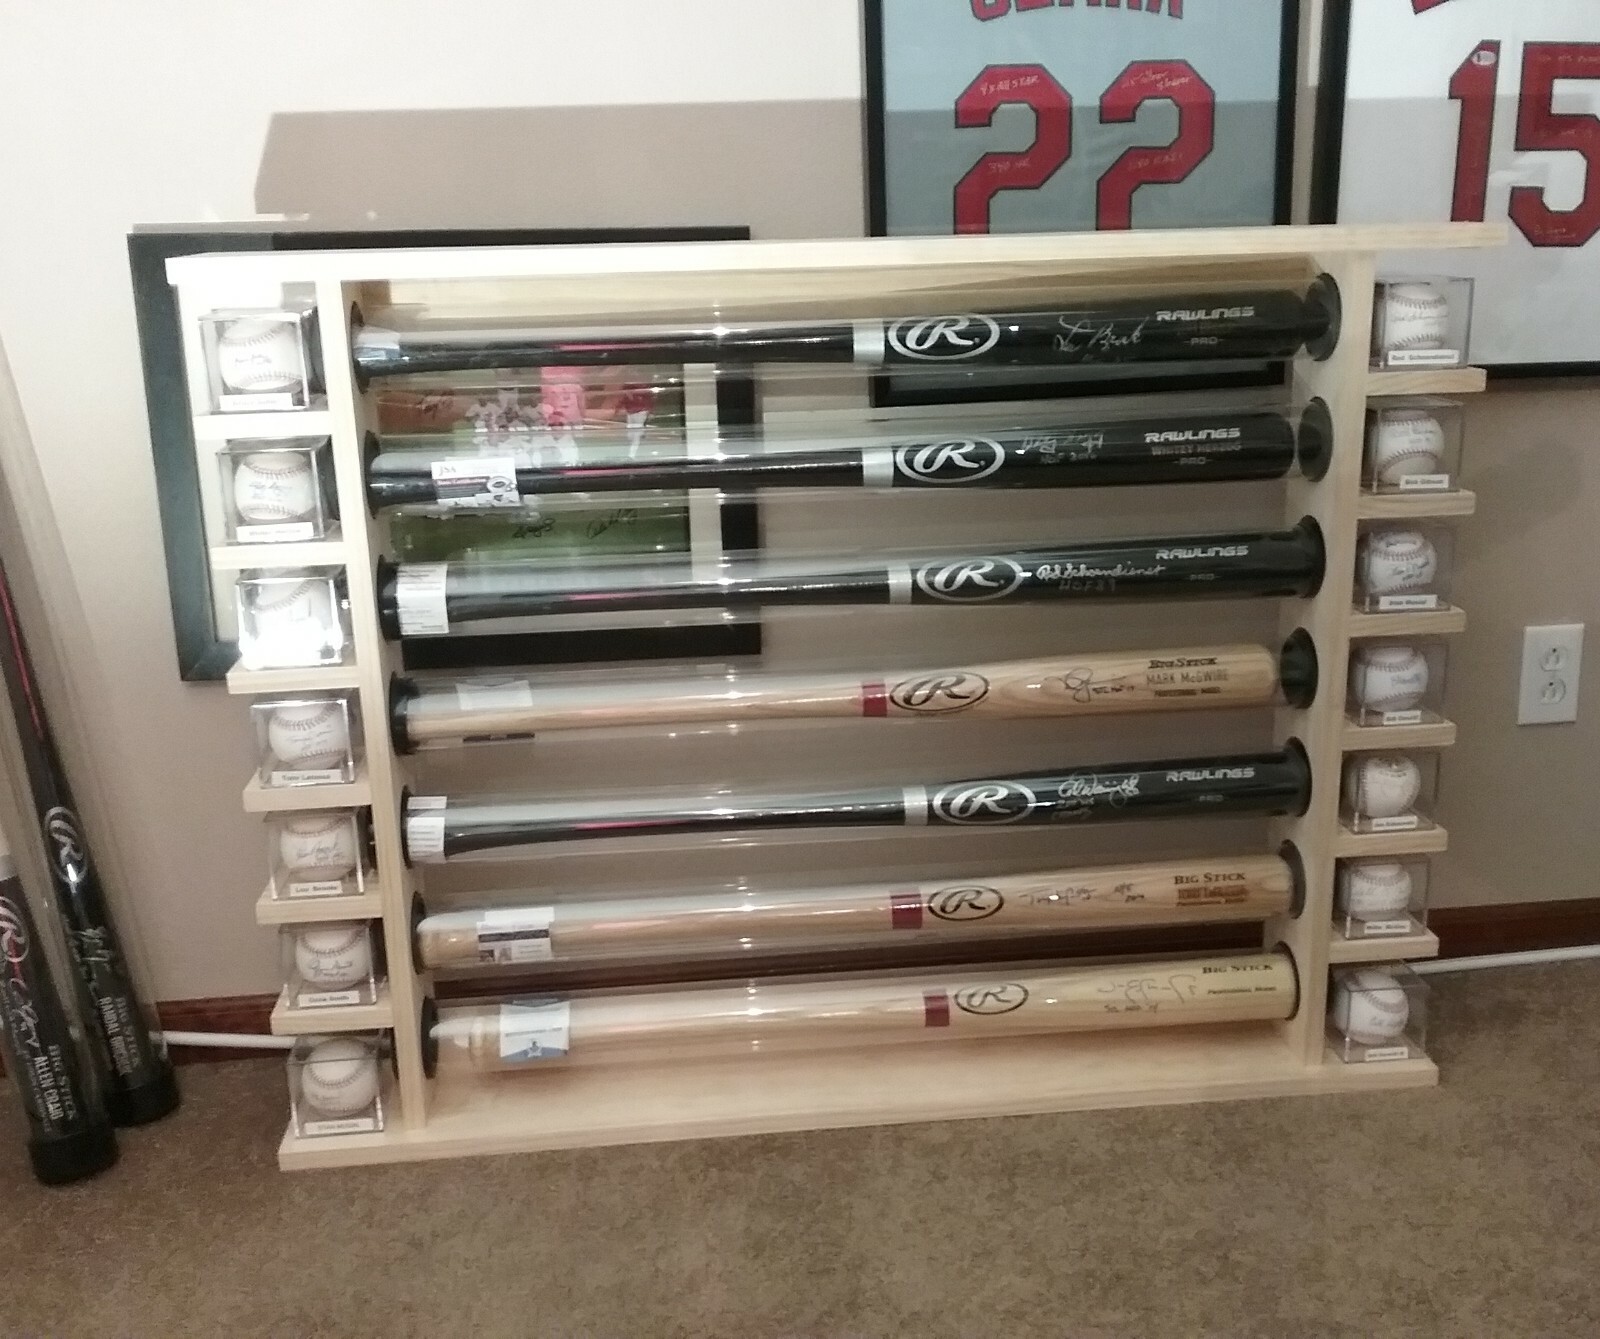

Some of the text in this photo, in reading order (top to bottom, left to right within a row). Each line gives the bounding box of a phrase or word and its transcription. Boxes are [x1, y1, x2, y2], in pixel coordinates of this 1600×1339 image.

[954, 59, 1216, 234] 22
[1155, 306, 1255, 322] RAWLINGS
[1143, 427, 1241, 443] RAWLINGS
[1155, 545, 1250, 560] RAWLINGS
[1147, 673, 1176, 684] MARK
[1165, 767, 1255, 783] RAWLINGS
[1174, 872, 1246, 885] BIG STICK
[33, 1055, 53, 1089] ALLEN
